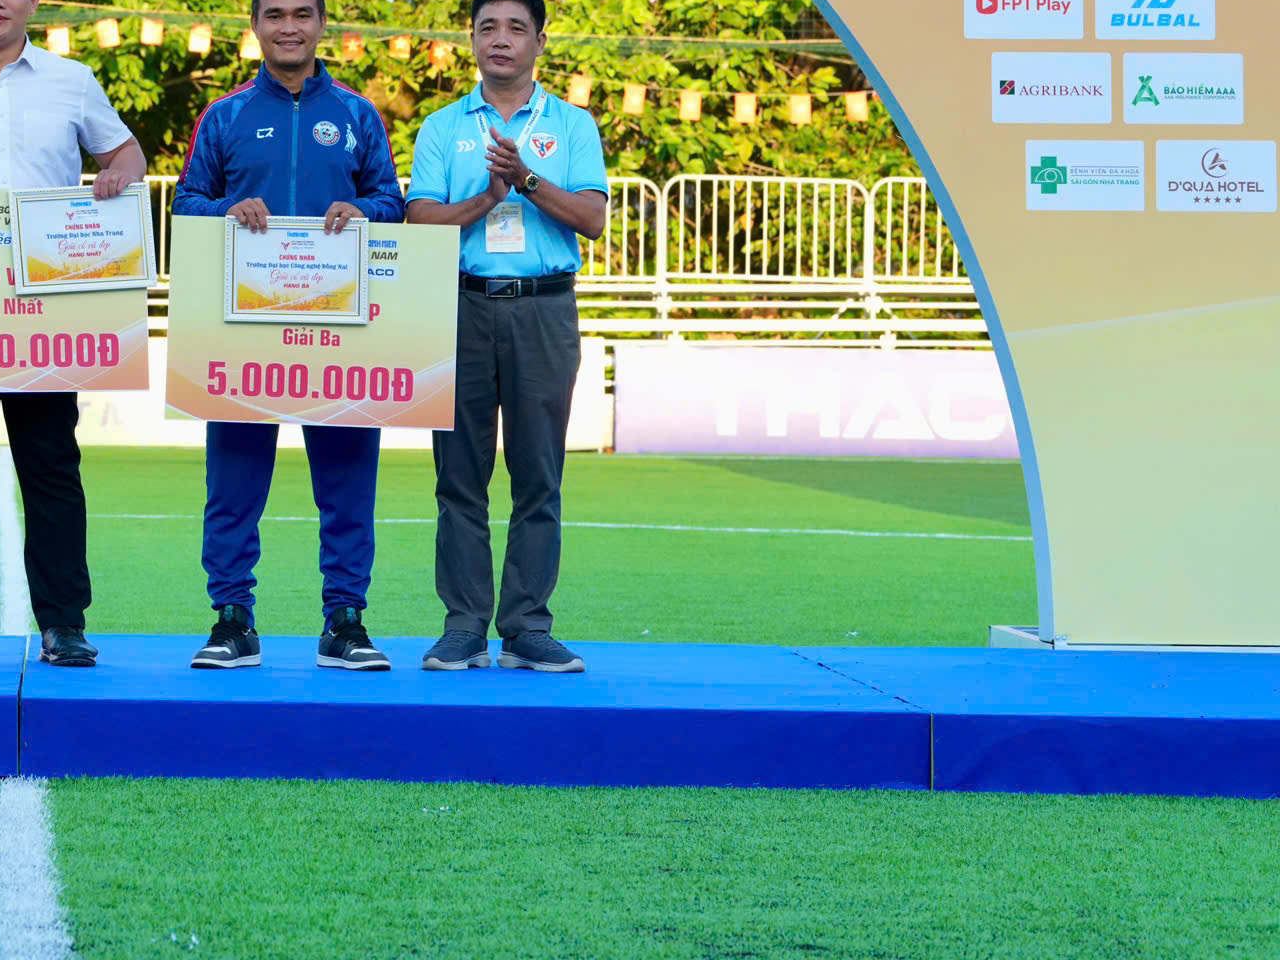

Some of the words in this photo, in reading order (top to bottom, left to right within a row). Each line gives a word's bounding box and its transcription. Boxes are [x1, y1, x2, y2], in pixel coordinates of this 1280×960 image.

[1110, 14, 1200, 27] BULBAL
[1018, 84, 1104, 97] AGRIBANK
[1164, 83, 1185, 95] BẢO
[1186, 82, 1214, 95] HIỂM
[1216, 87, 1236, 95] AAA
[528, 109, 540, 127] THACO
[1218, 180, 1264, 192] HOTEL
[371, 251, 399, 260] NAM
[4, 297, 43, 315] Nhất
[283, 326, 313, 347] Giải
[320, 330, 340, 347] Ba
[207, 360, 413, 402] 5.000.000Đ
[683, 370, 1009, 440] THAC
